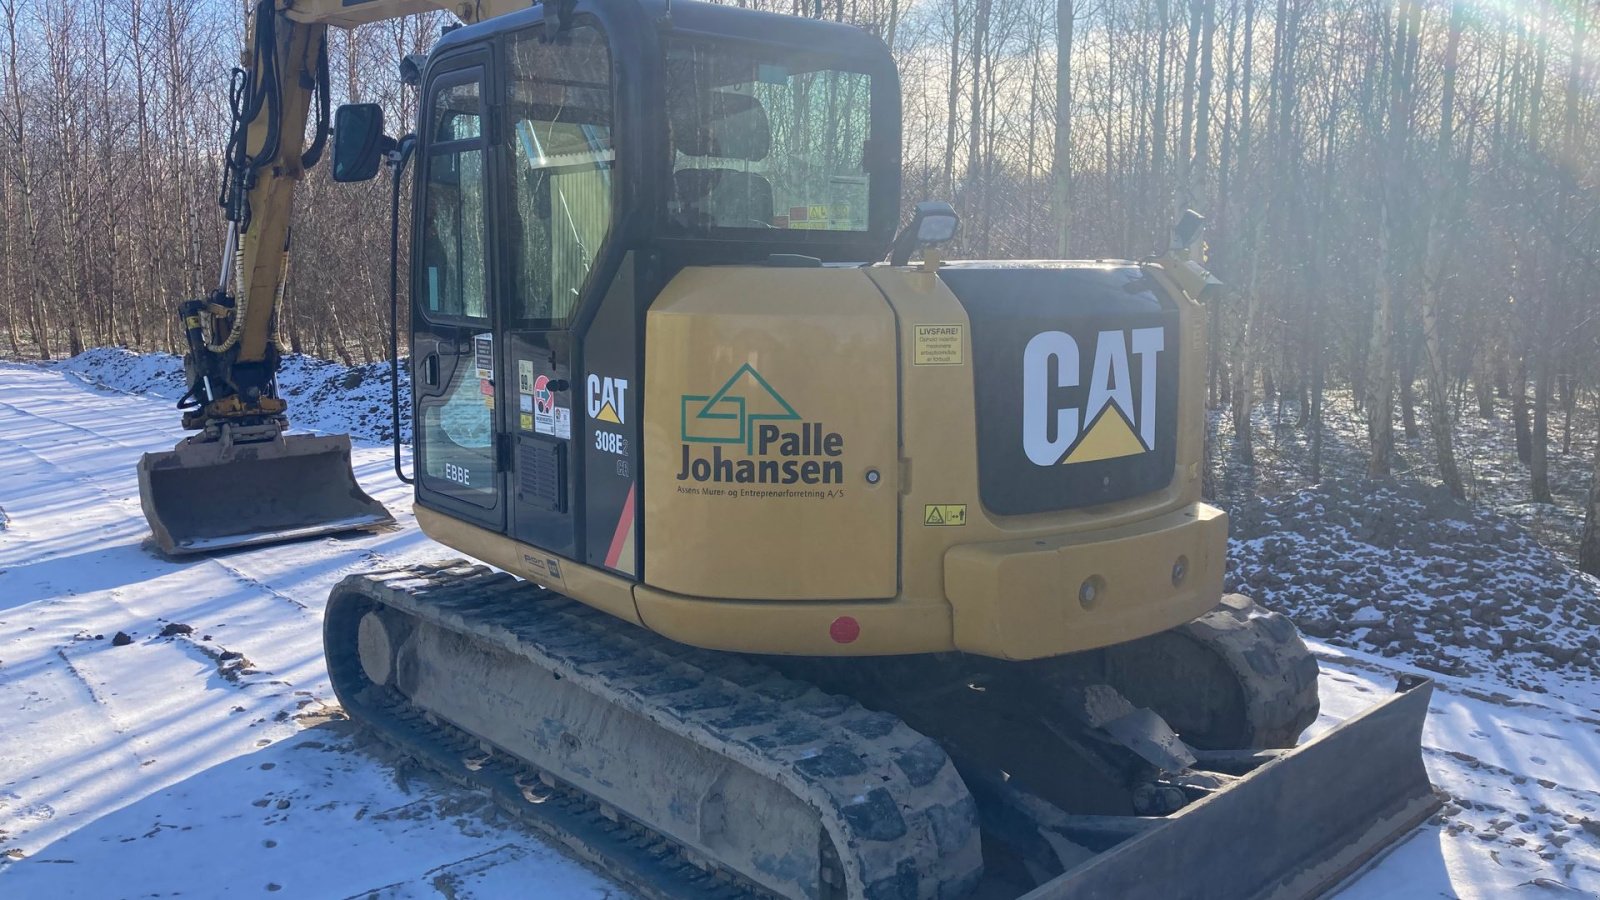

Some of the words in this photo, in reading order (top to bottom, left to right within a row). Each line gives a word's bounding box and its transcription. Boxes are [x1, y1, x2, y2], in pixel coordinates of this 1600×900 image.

[919, 327, 959, 335] LIVSFARE!
[587, 373, 628, 425] CAT
[1023, 326, 1165, 466] CAT
[758, 422, 843, 457] Palle
[445, 462, 470, 486] EBBE
[676, 444, 843, 485] Johansen
[677, 485, 700, 495] Assens
[728, 490, 738, 499] og
[740, 488, 825, 500] Entreprenørforretning
[827, 489, 845, 499] A/S
